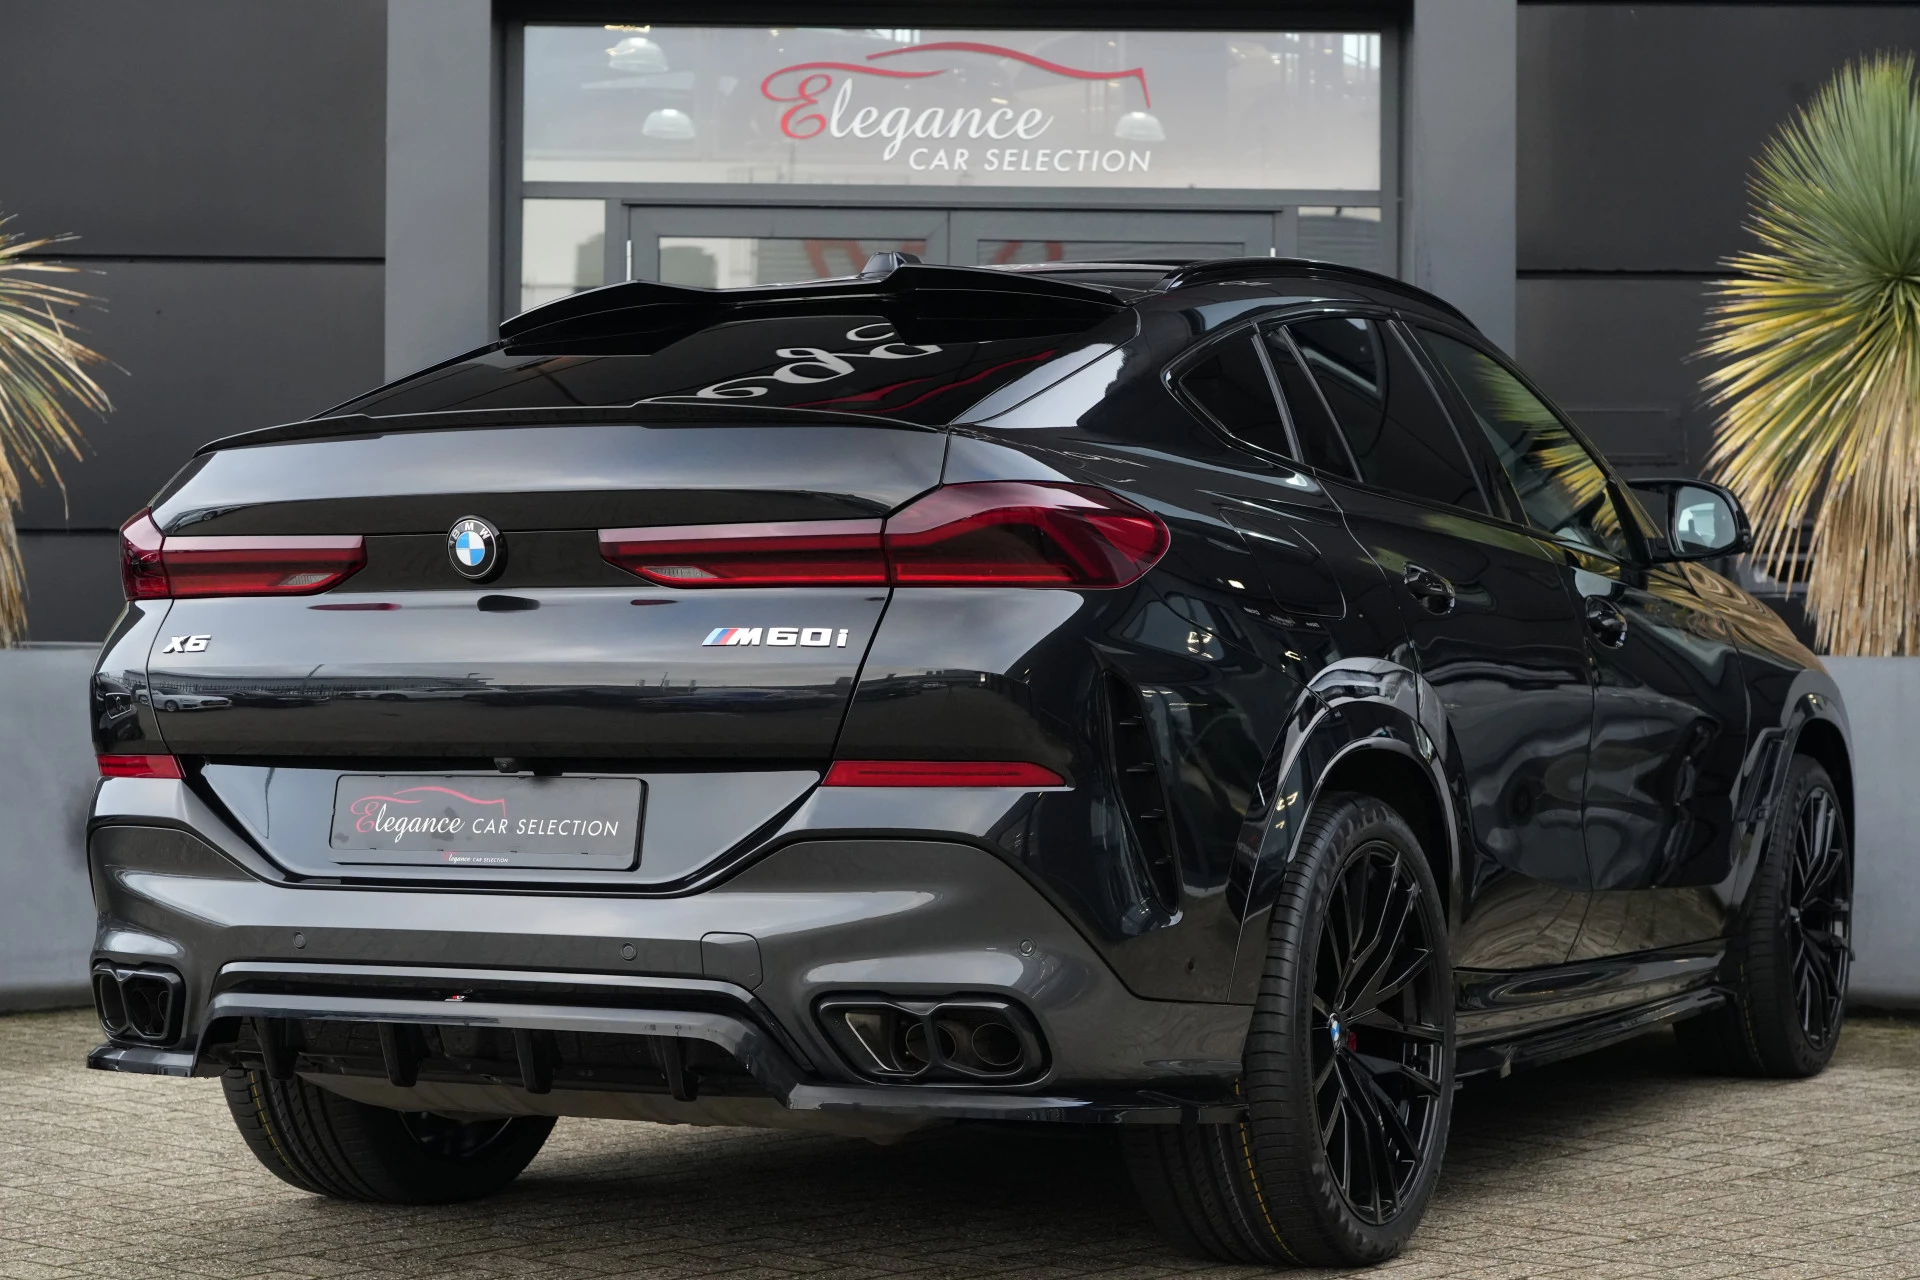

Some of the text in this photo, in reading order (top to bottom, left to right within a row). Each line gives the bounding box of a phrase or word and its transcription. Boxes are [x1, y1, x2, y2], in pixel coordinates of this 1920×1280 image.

[762, 70, 1054, 161] Elegance
[909, 147, 1151, 172] CAR SELECTION
[450, 522, 491, 541] BMW
[162, 634, 212, 654] X6
[702, 627, 849, 648] M60i
[352, 801, 619, 844] Elegance CAR SELECTION
